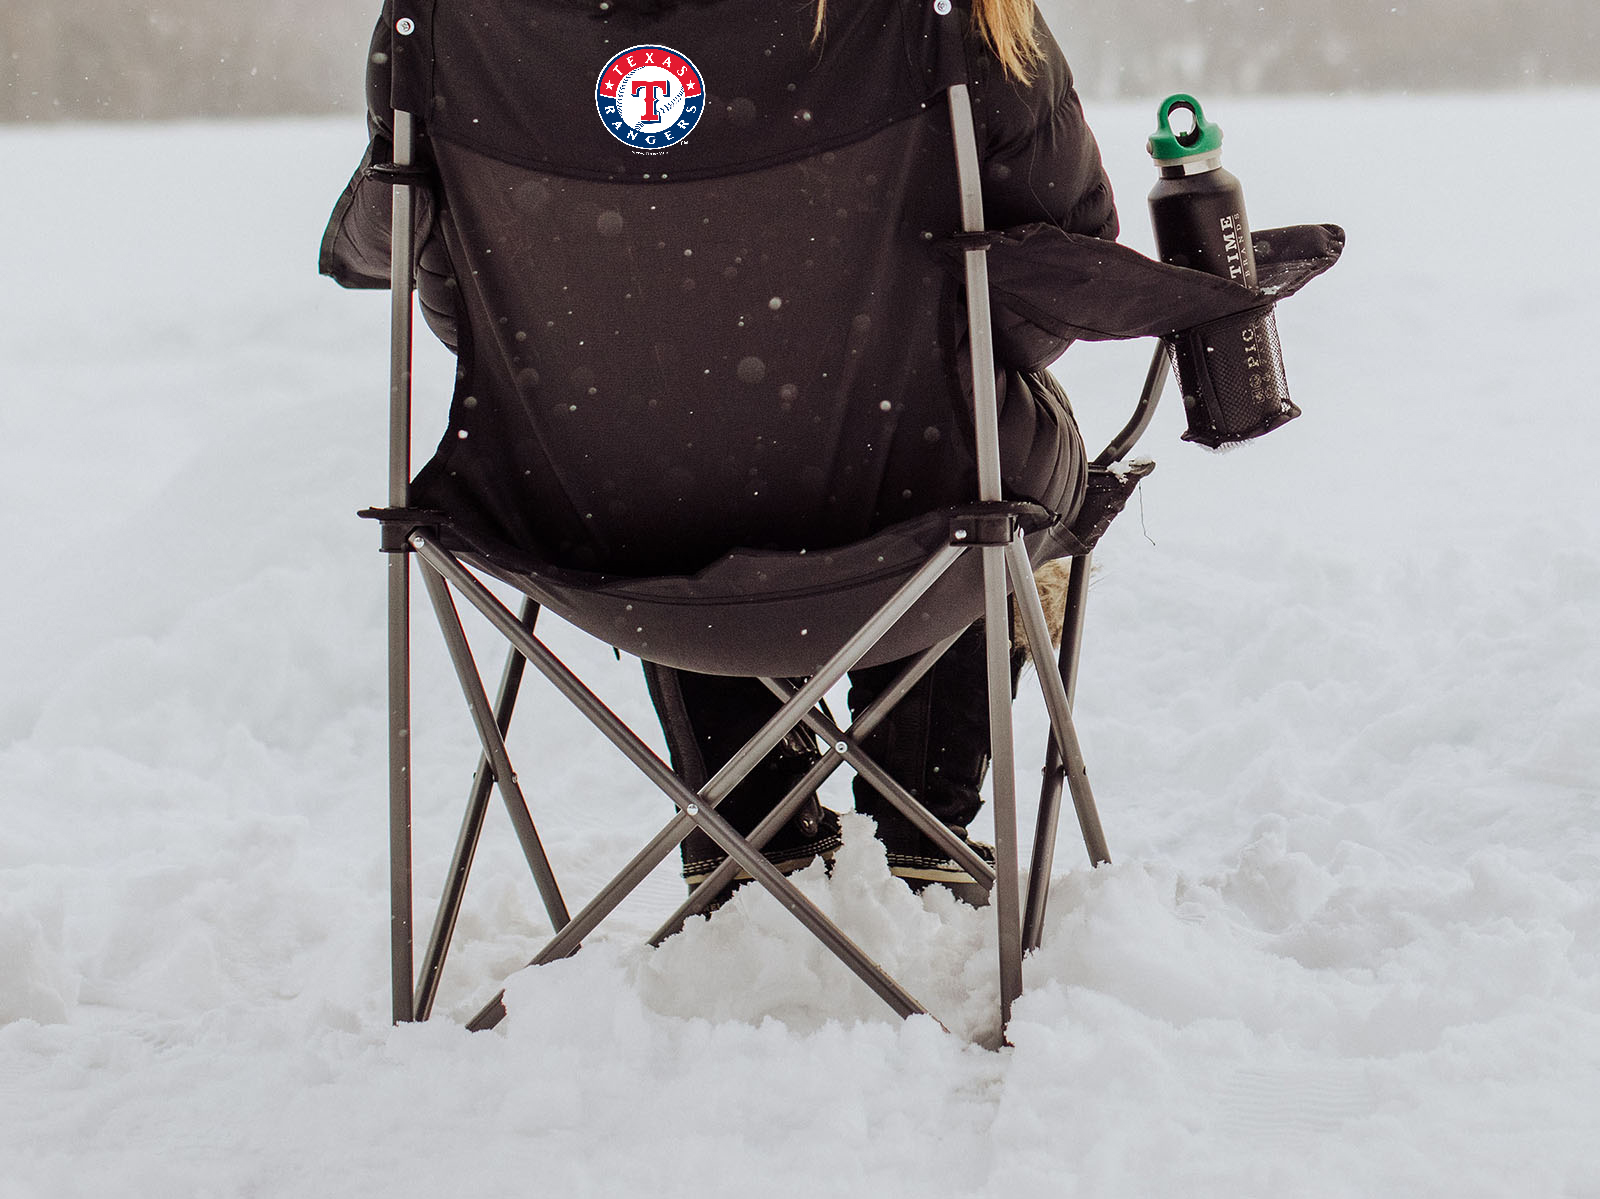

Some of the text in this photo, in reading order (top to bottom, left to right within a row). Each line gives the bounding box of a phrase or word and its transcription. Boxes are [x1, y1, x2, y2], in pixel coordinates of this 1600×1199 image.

[612, 52, 688, 77] TEXAS
[631, 80, 671, 124] T
[604, 105, 697, 145] RANGERS
[1220, 215, 1242, 279] TIME
[1233, 213, 1251, 278] BRANDS
[1242, 328, 1260, 369] PIC
